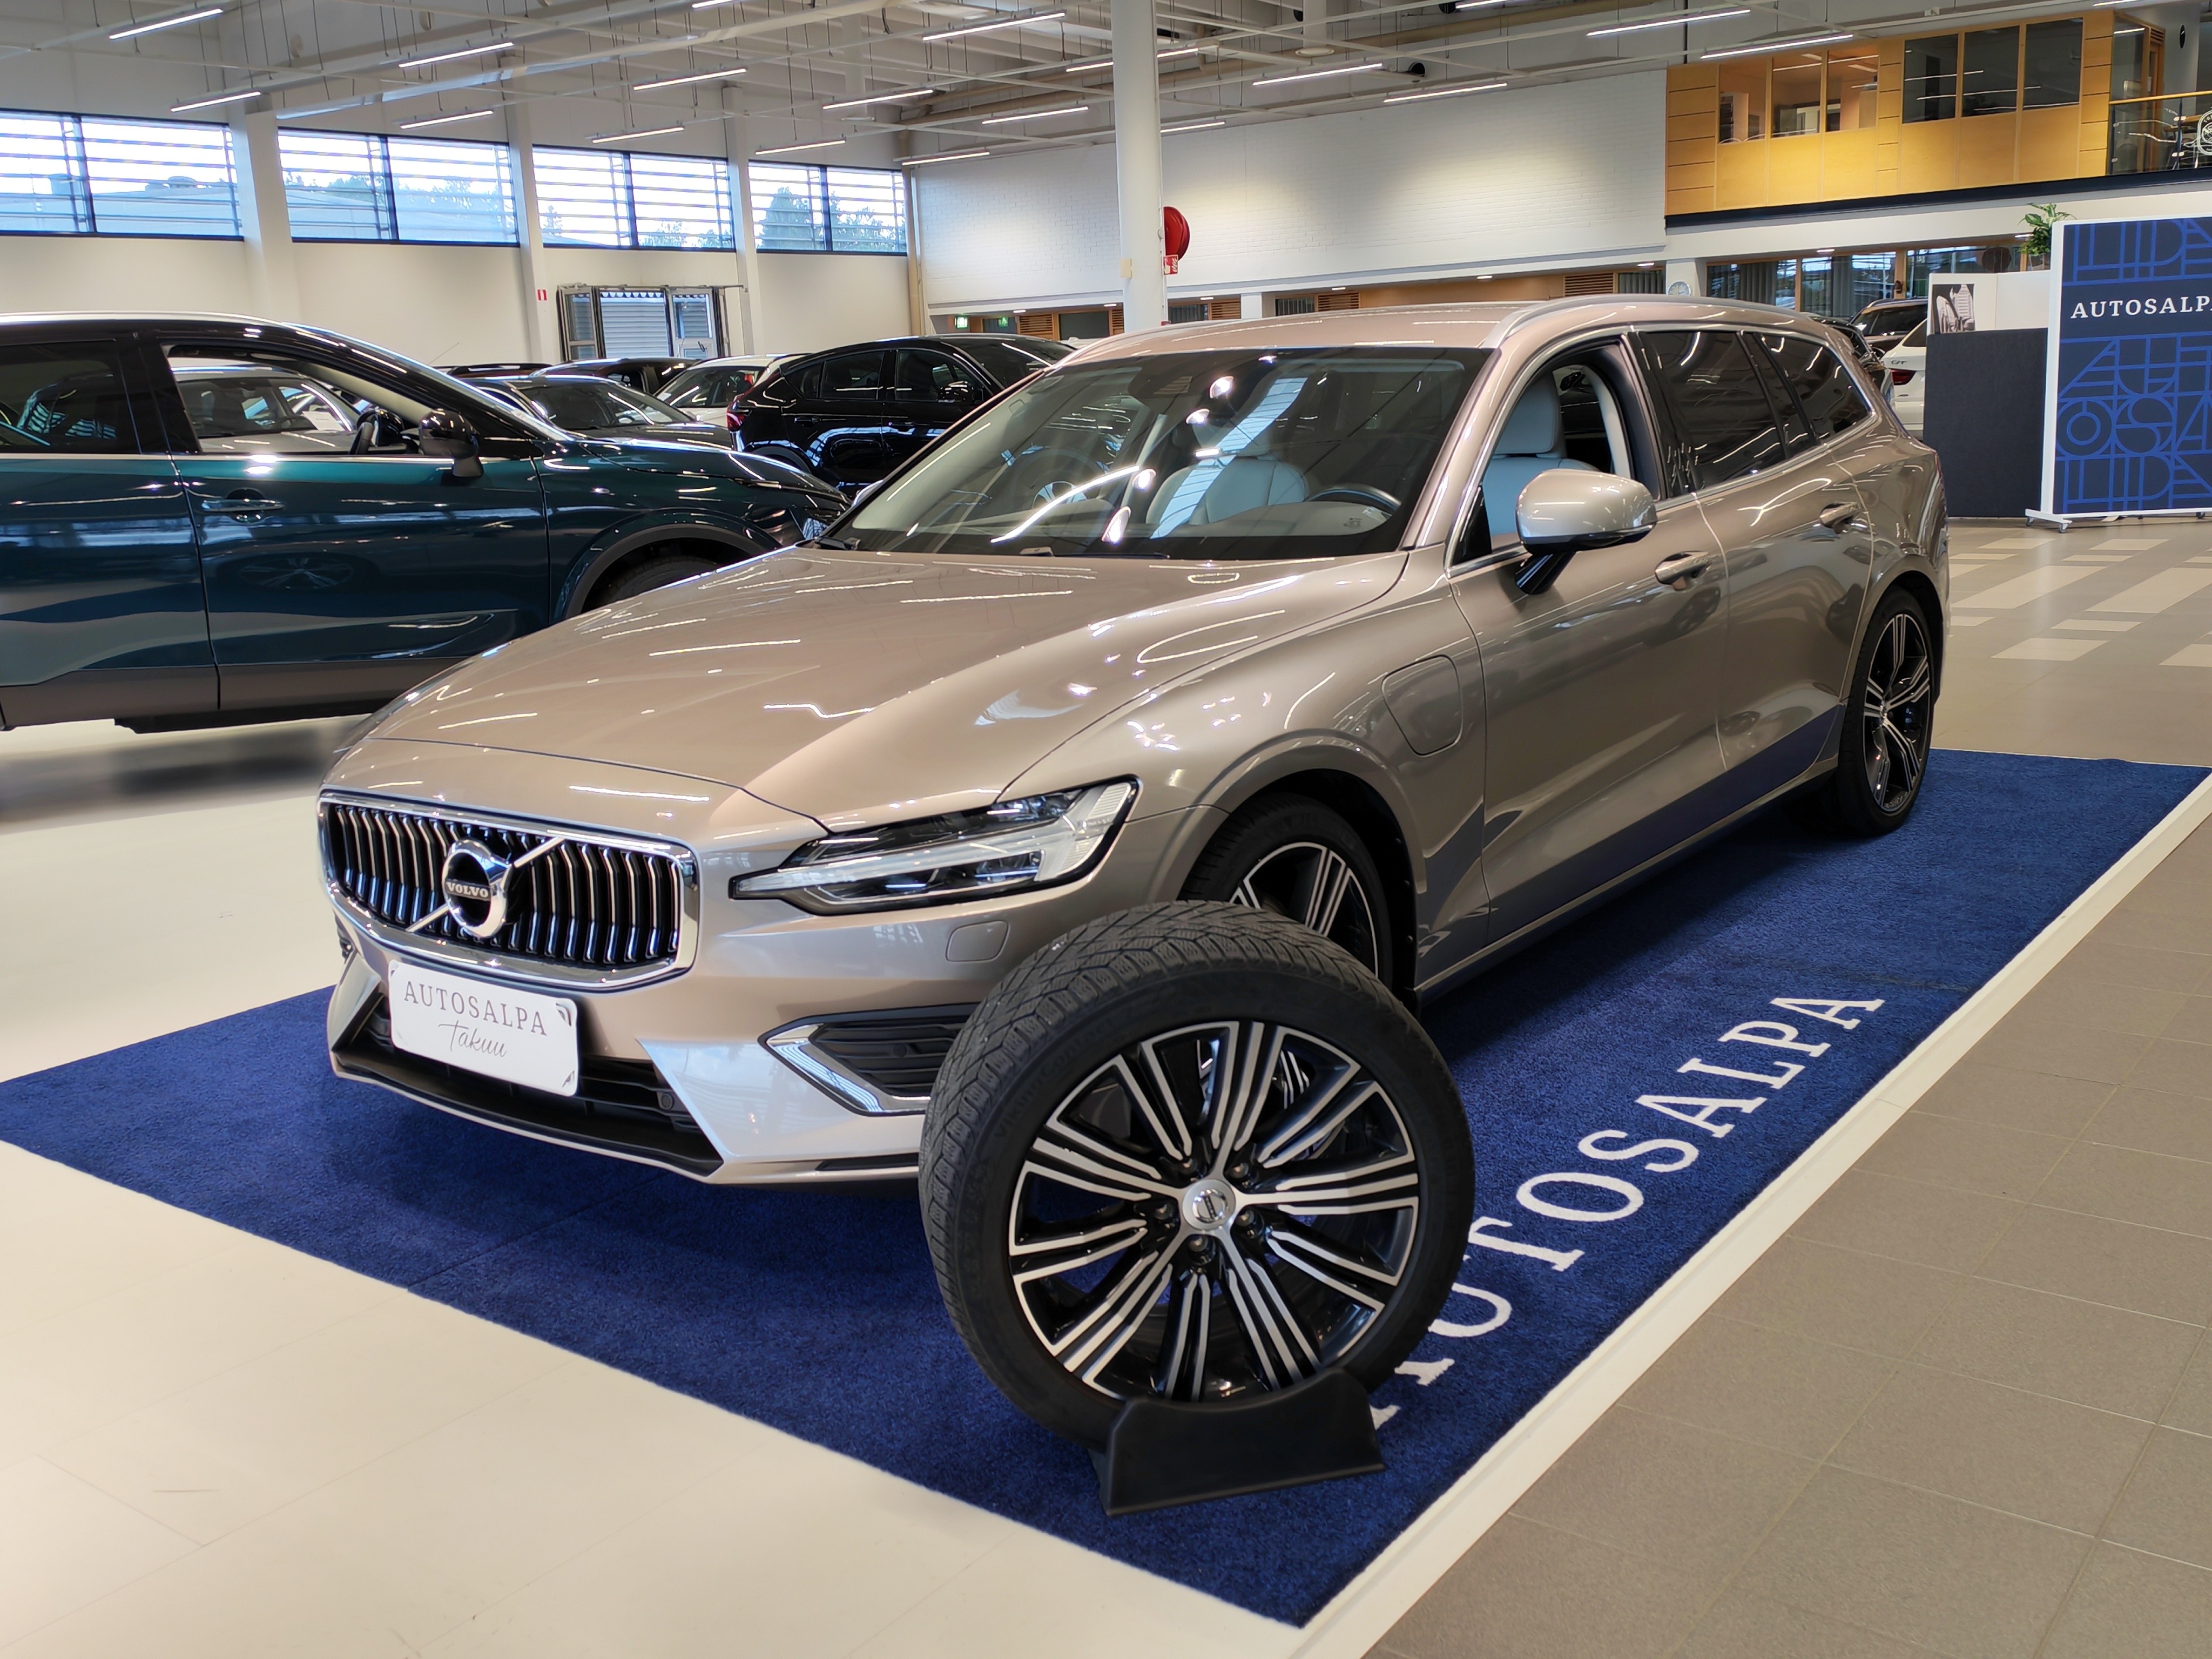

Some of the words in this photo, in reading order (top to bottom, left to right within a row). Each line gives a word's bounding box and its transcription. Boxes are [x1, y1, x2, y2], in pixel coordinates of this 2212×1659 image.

[2070, 295, 2212, 319] AUTOSALP
[446, 881, 489, 898] VOLVO
[404, 980, 548, 1036] AUTOSALPA
[438, 1020, 507, 1058] Takuu
[1370, 997, 1886, 1430] UTOSALPA
